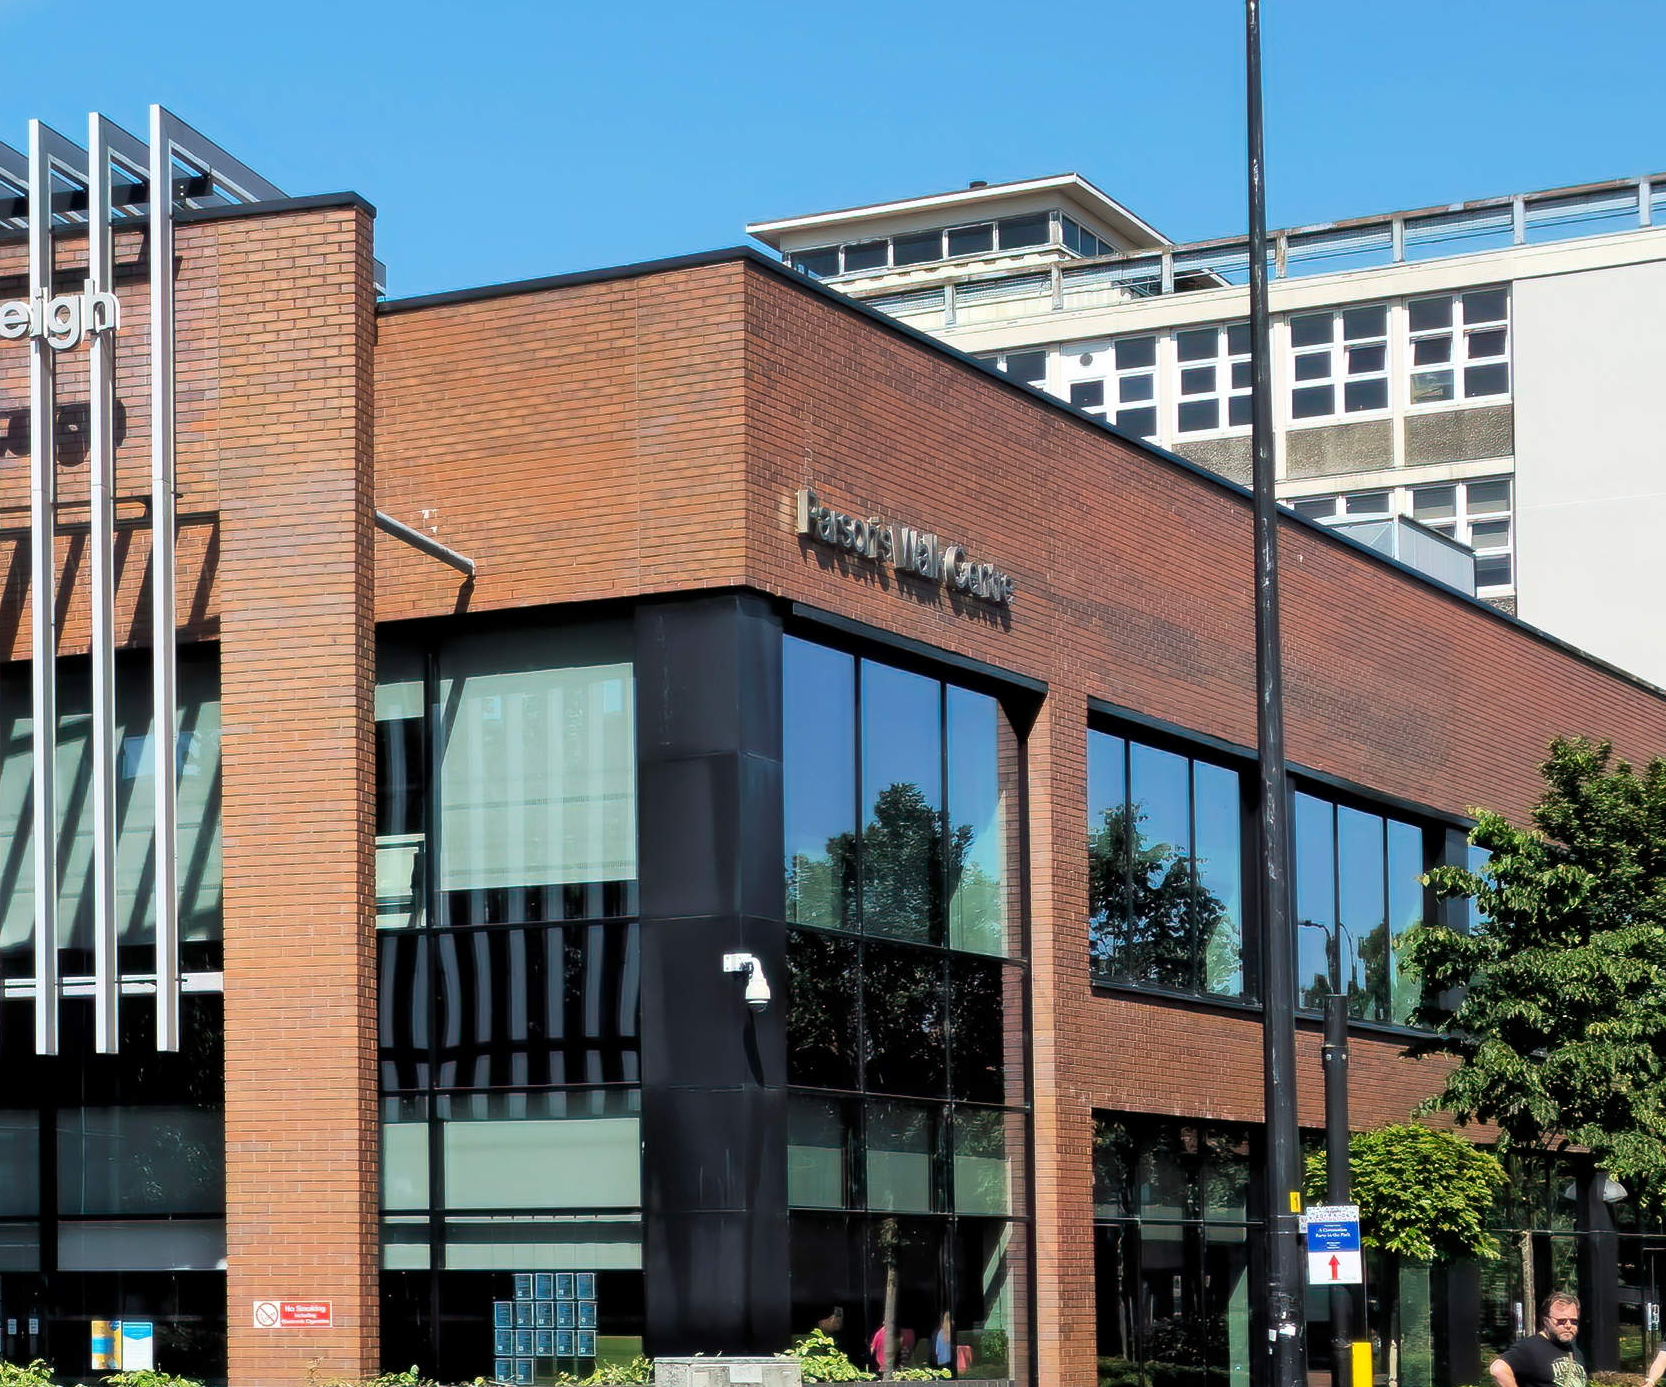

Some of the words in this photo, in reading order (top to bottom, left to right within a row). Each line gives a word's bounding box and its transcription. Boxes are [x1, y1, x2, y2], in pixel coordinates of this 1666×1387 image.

[795, 489, 895, 560] Parson's
[945, 544, 1015, 606] Centre
[295, 1305, 326, 1313] Smoking
